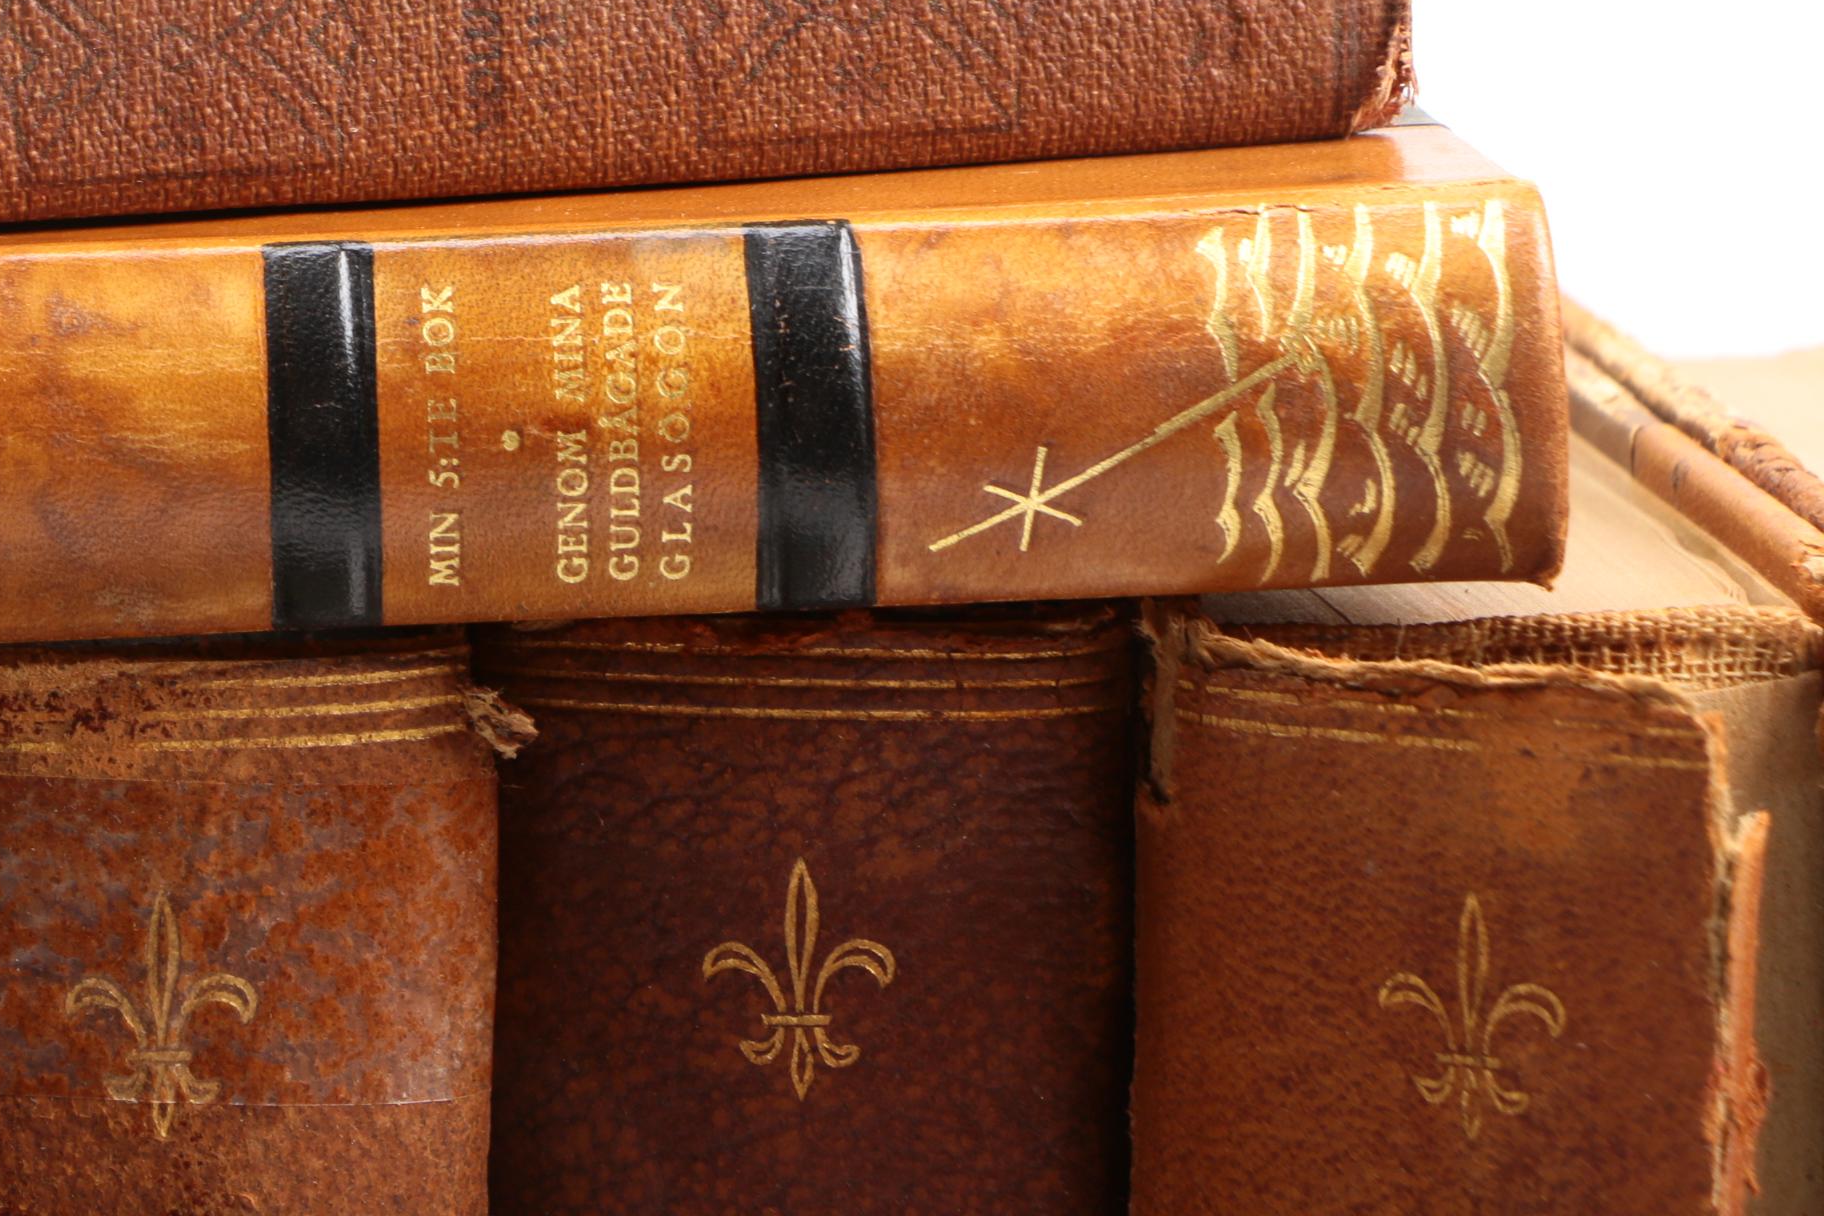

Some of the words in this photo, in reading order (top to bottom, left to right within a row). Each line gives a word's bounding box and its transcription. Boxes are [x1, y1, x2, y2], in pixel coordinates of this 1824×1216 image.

[419, 284, 456, 376] BOK
[550, 284, 587, 404] MINA
[596, 280, 642, 582] GULDBÅGADE
[651, 281, 695, 581] GLASÖGON
[428, 511, 461, 587] MIN
[555, 428, 590, 585] GENOM
